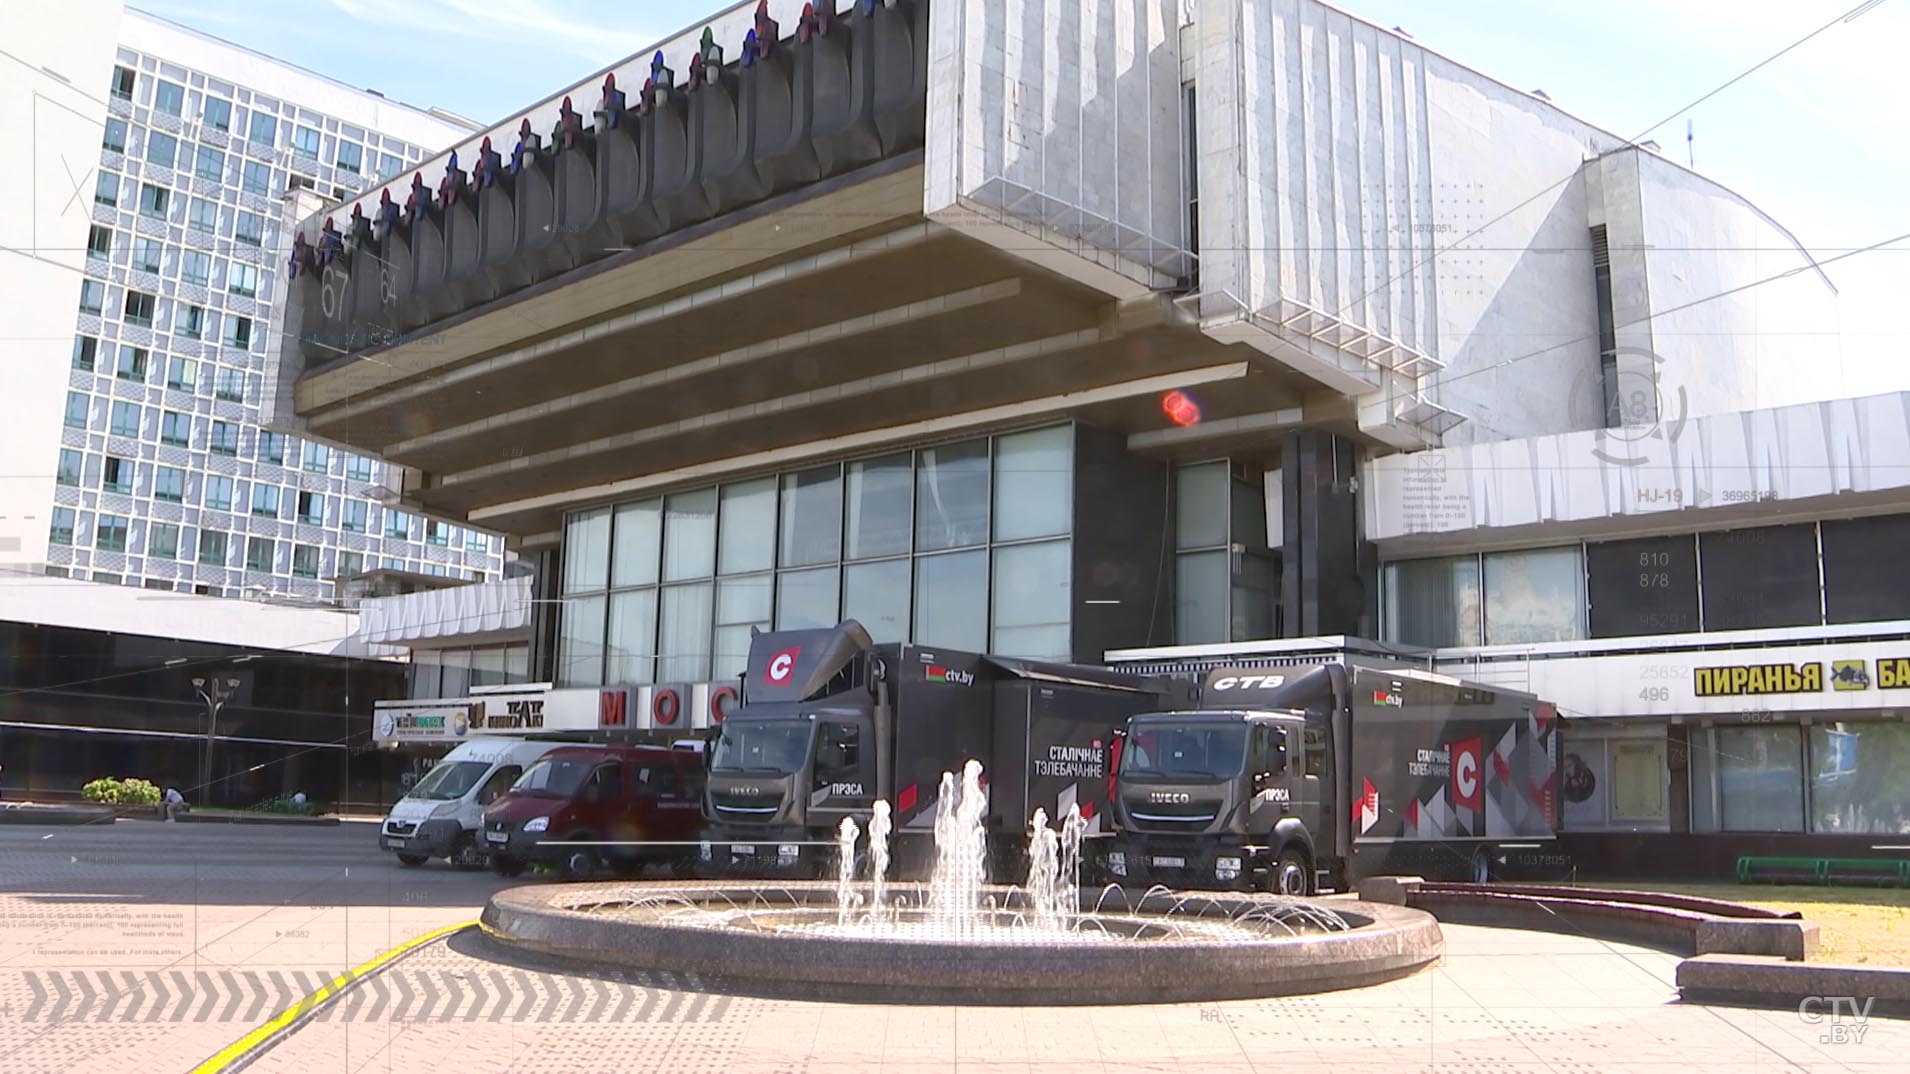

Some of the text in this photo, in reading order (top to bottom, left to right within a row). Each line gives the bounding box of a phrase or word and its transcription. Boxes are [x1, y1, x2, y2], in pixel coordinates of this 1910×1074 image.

[945, 669, 974, 687] ctv.by
[1694, 662, 1823, 697] ПИРАНЬЯ
[1034, 760, 1102, 779] ТЭЛЕБАЧАННЕ
[730, 786, 759, 796] IVECO
[831, 783, 863, 796] ПРЭСА
[1150, 792, 1190, 803] IVECO
